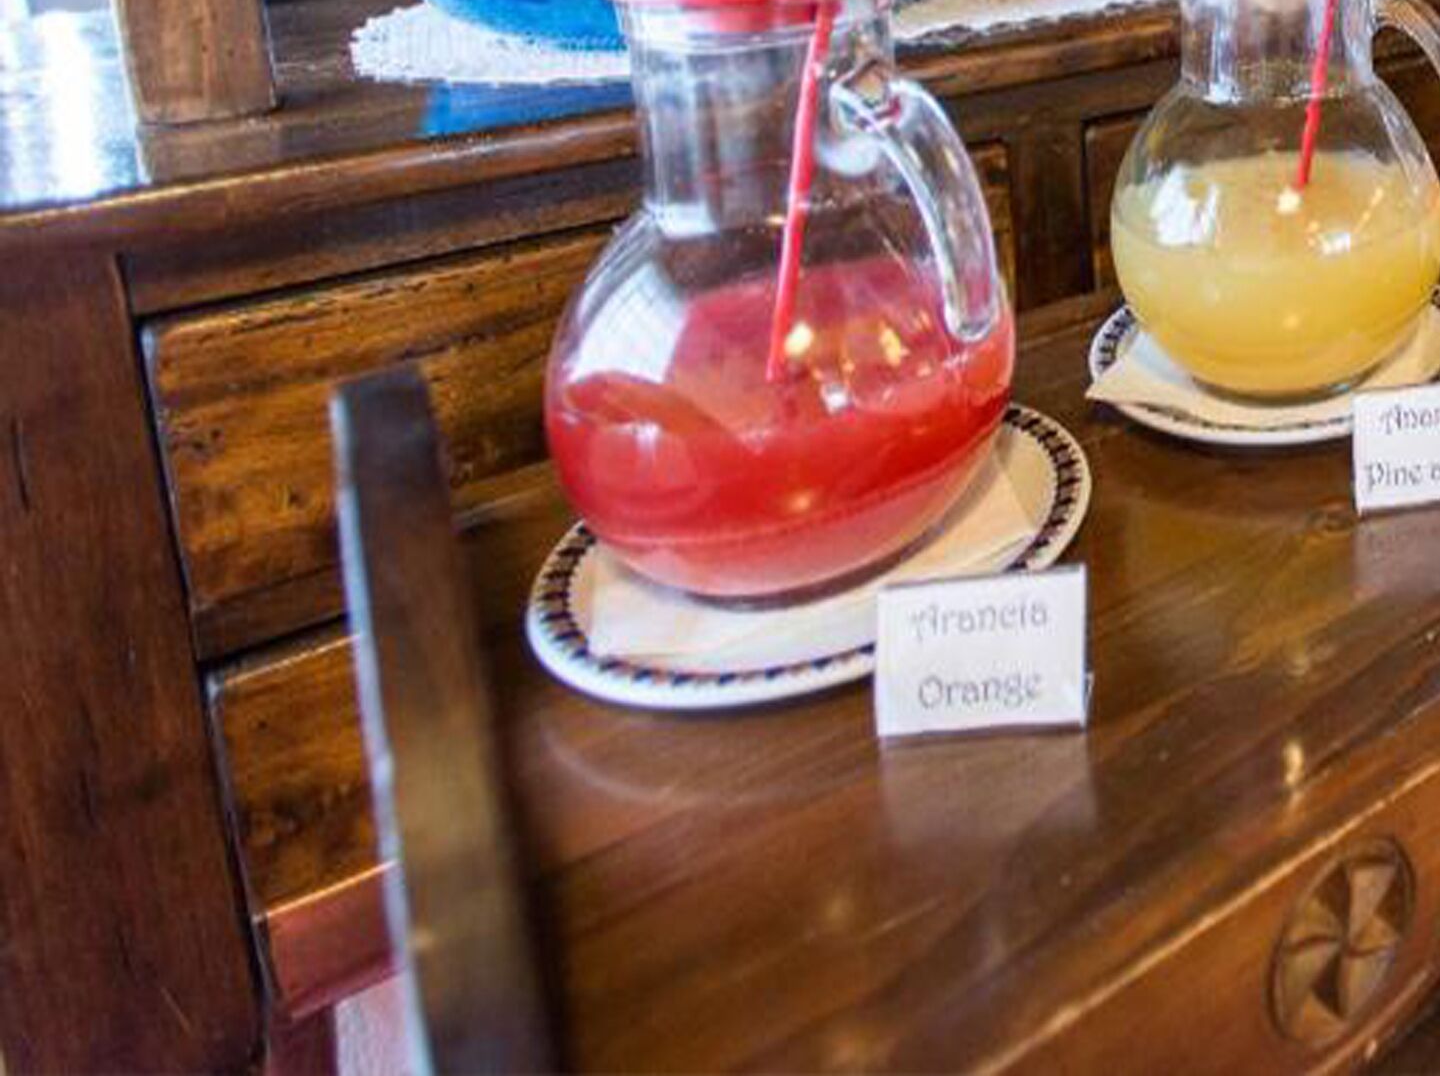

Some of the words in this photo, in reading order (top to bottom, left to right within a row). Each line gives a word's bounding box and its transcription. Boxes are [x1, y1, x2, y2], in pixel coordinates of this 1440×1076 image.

[1364, 461, 1422, 492] Pine
[907, 599, 1048, 643] Arancia
[917, 671, 1043, 710] Orange
